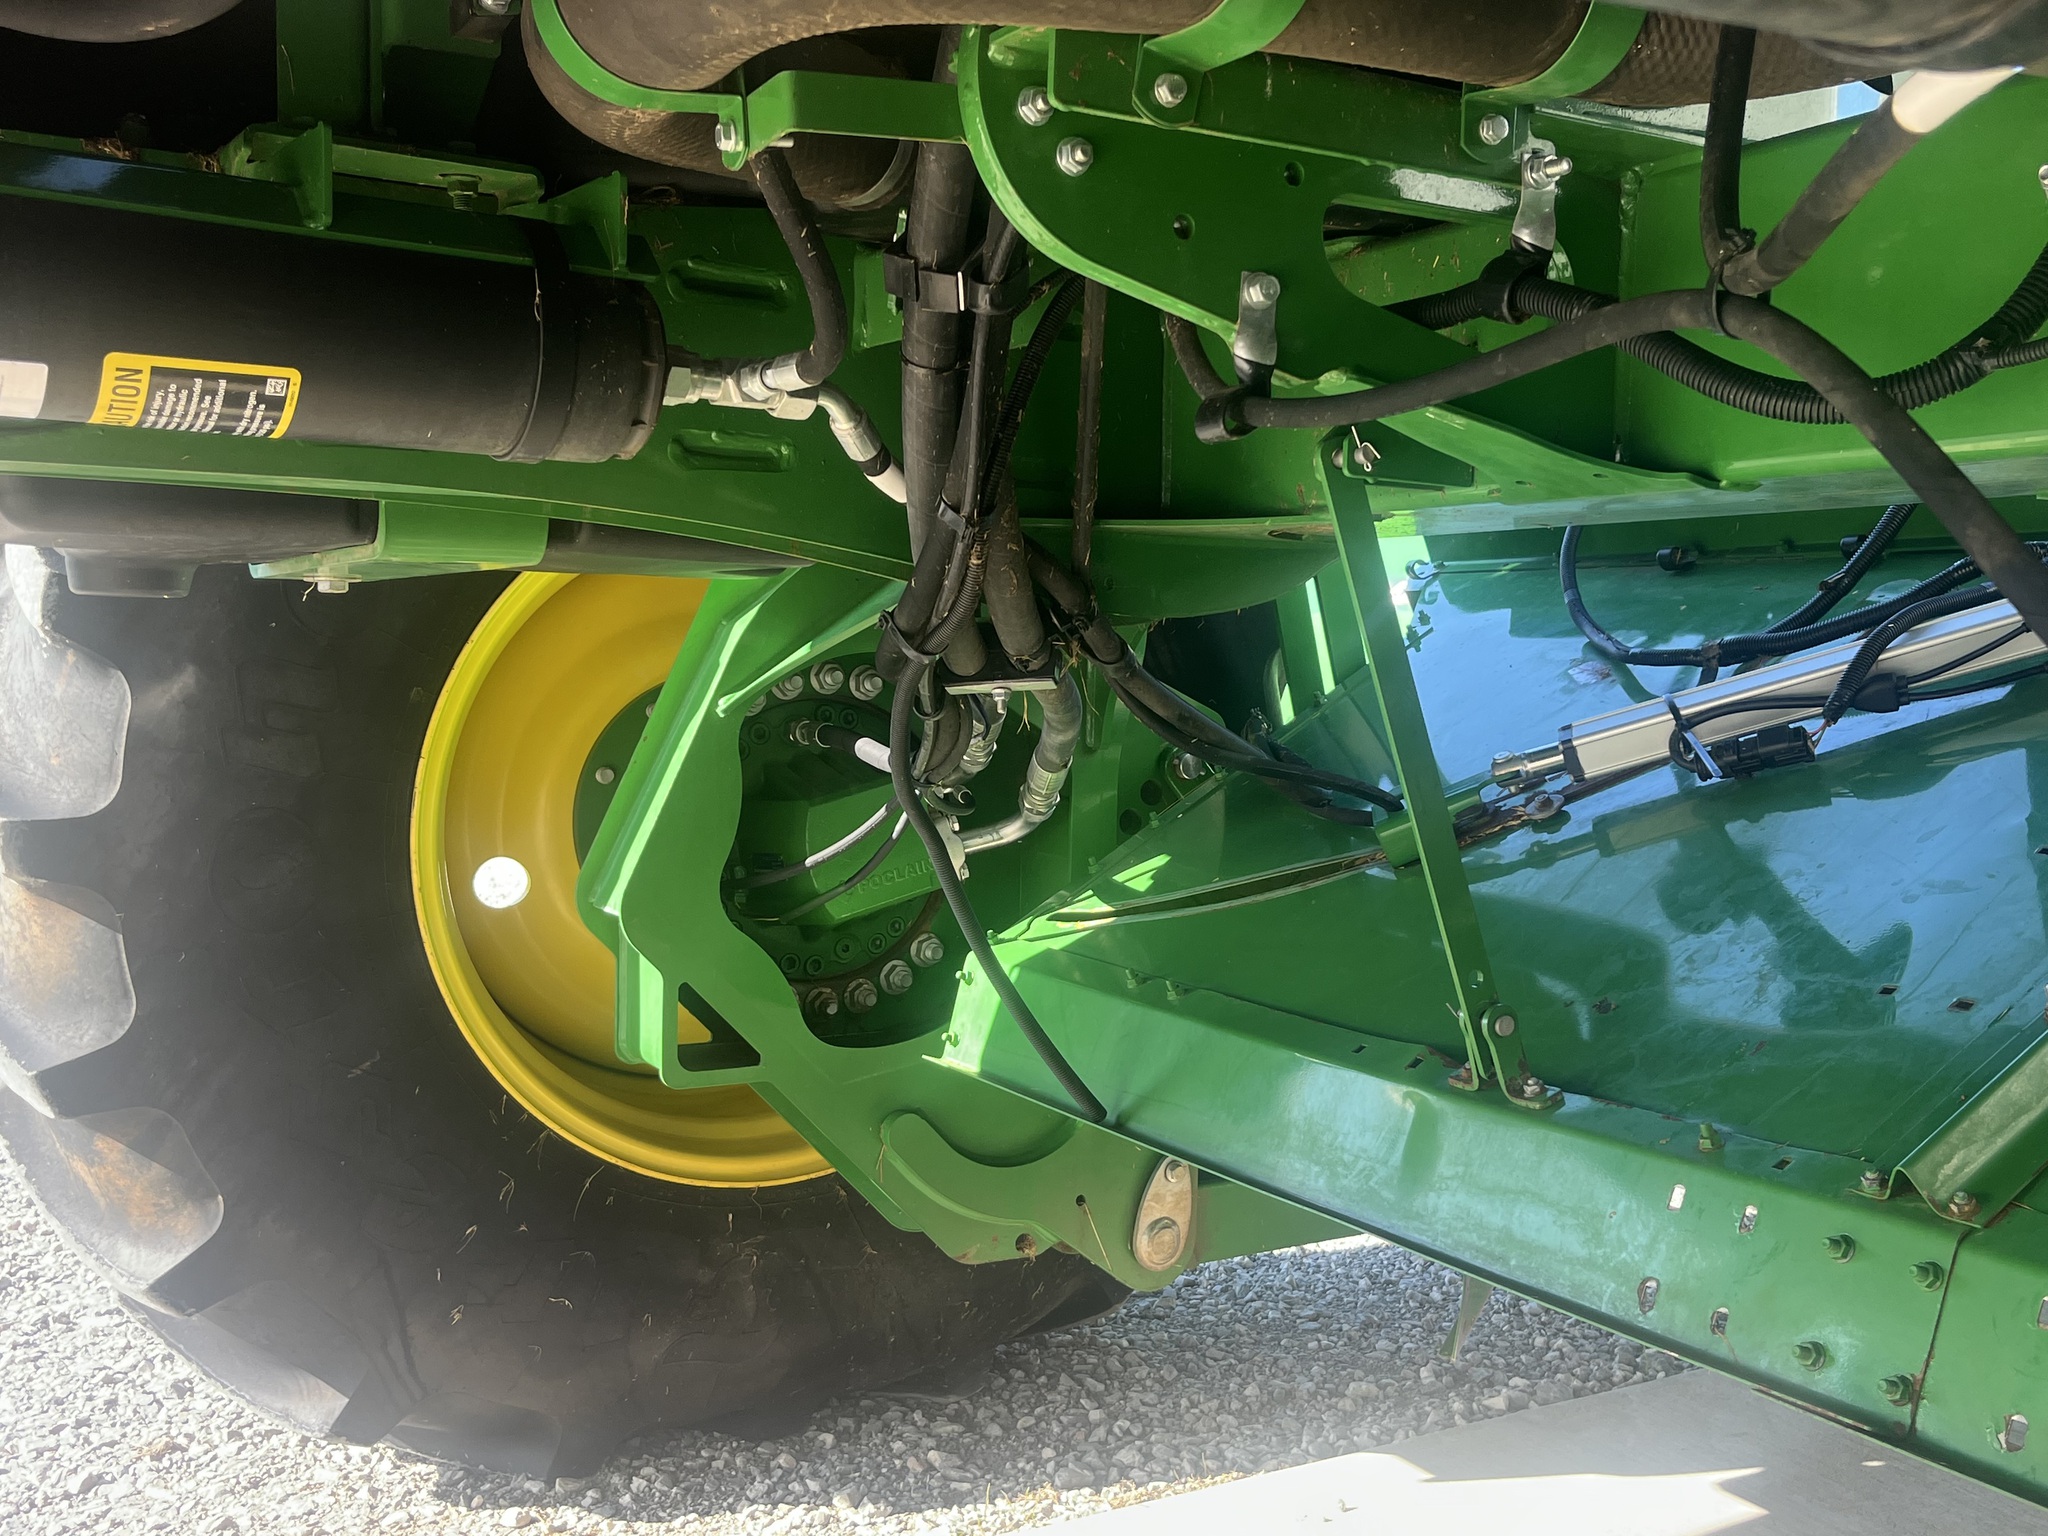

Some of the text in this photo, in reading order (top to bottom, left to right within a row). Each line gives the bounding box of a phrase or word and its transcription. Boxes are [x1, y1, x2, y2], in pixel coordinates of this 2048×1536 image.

[101, 367, 143, 426] AUTION
[168, 383, 177, 392] to
[201, 395, 212, 408] See
[213, 379, 227, 414] additional
[173, 389, 188, 417] hydraulic
